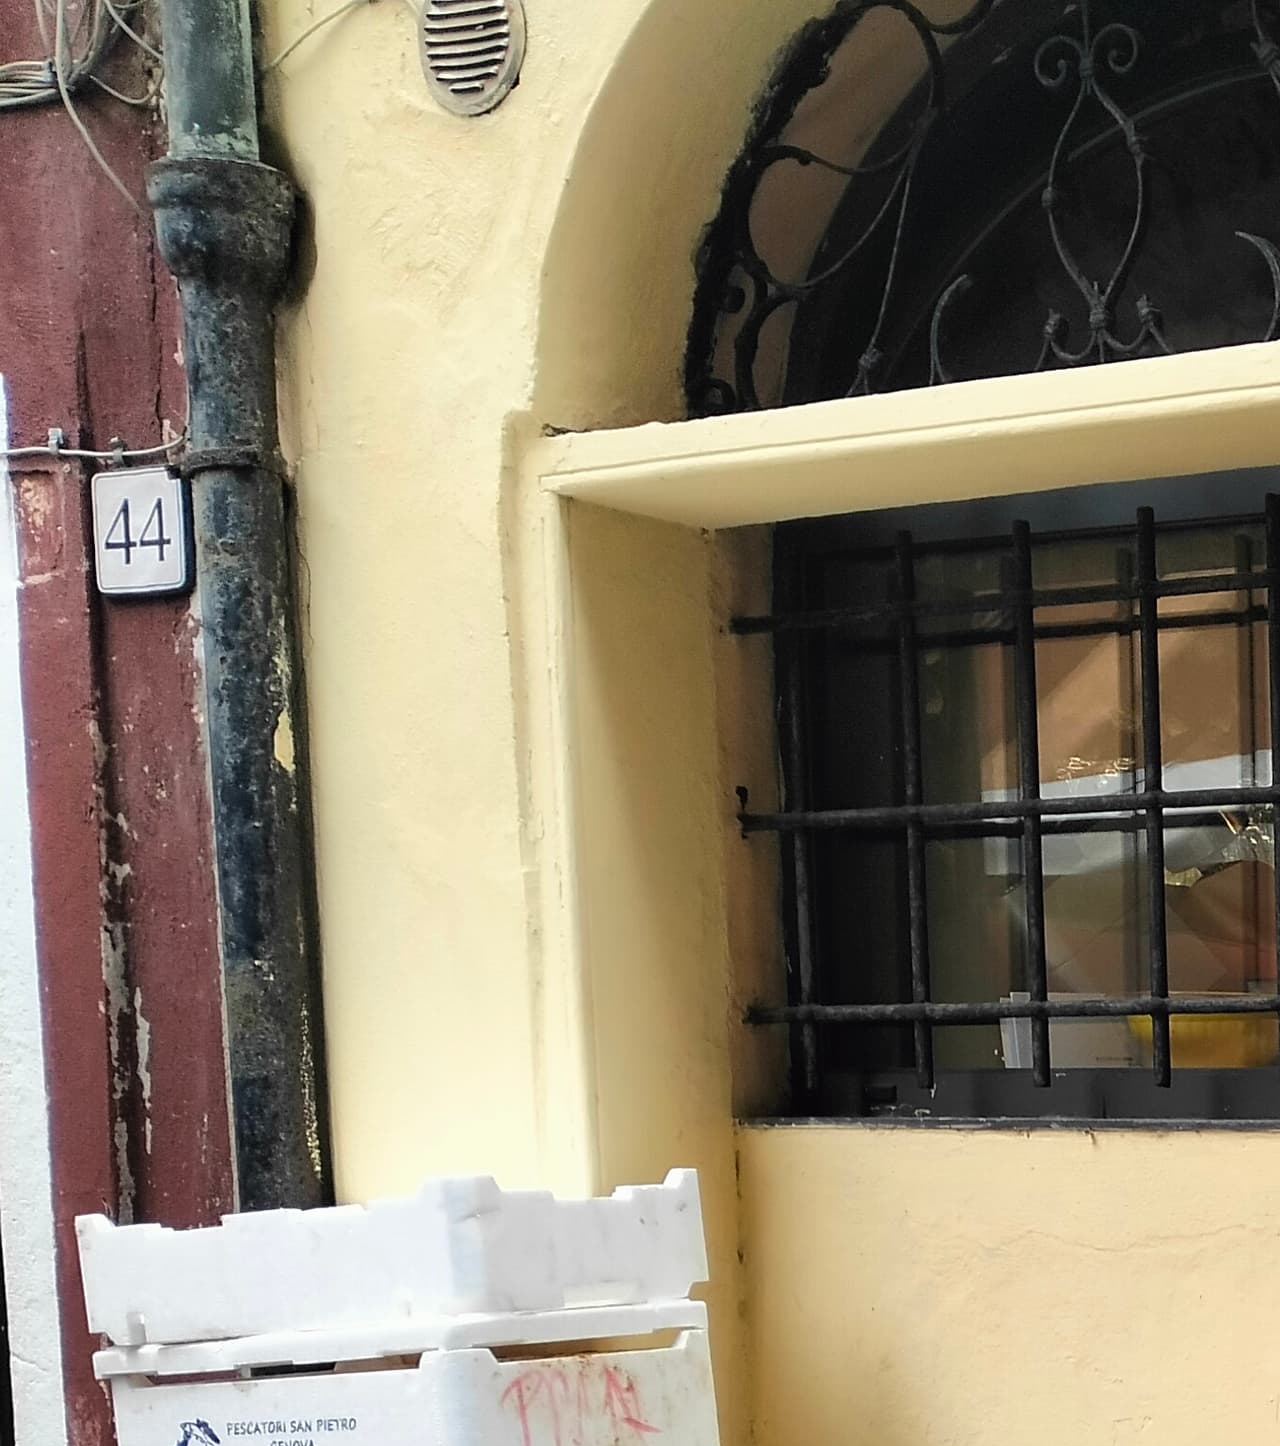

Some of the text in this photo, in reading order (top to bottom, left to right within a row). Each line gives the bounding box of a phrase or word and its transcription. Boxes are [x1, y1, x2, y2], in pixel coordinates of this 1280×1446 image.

[104, 497, 171, 565] 44
[227, 1418, 357, 1435] PESCATORI SAN PIETRO
